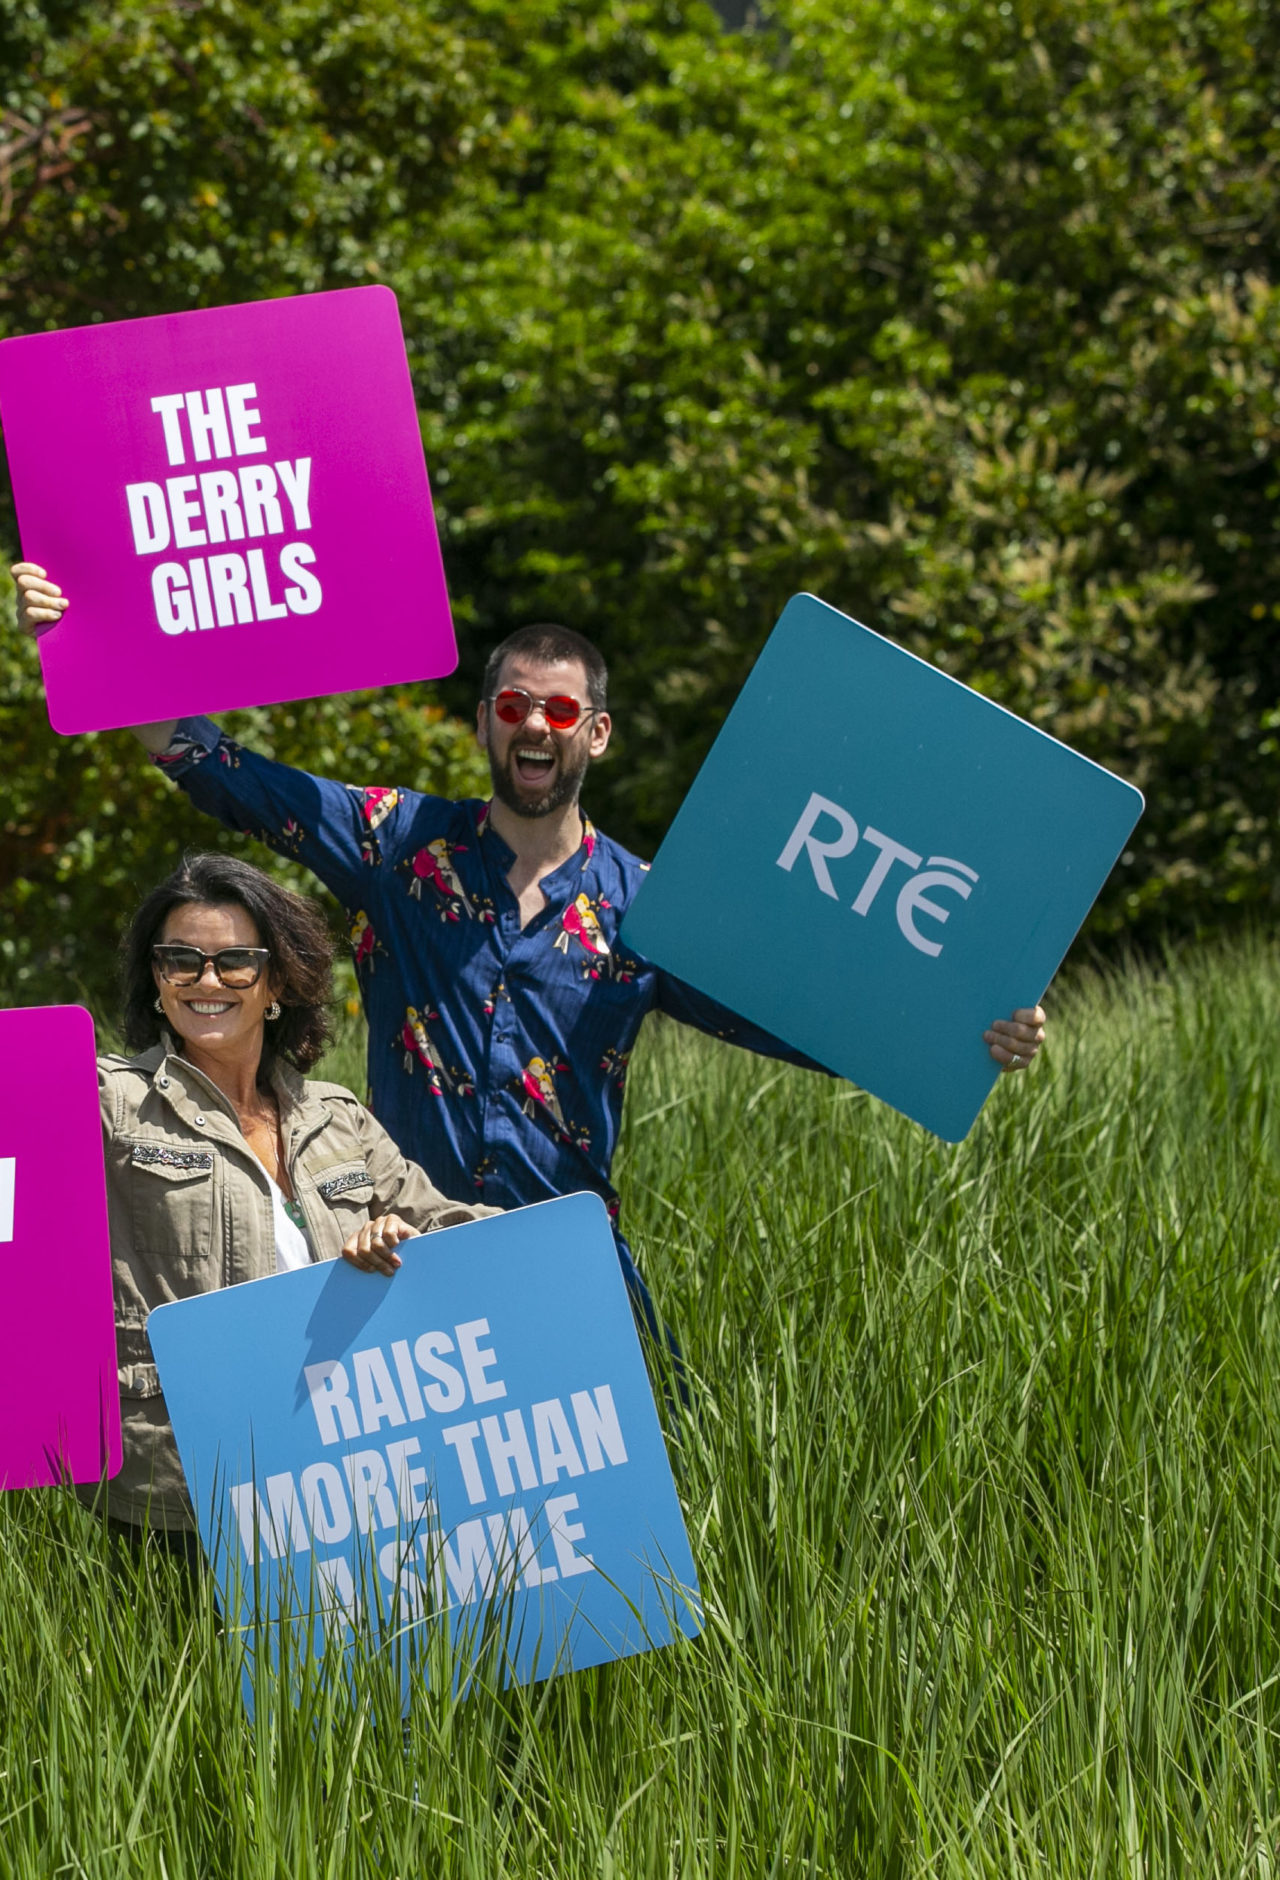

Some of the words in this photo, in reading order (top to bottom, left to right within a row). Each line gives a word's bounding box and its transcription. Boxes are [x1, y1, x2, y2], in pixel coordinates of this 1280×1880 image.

[151, 383, 267, 466] THE
[126, 457, 312, 555] DERRY
[152, 542, 322, 635] GIRLS
[304, 1318, 507, 1445] RAISE
[228, 1437, 438, 1566] MORE
[442, 1384, 628, 1505] THAN
[379, 1493, 596, 1622] SMILE
